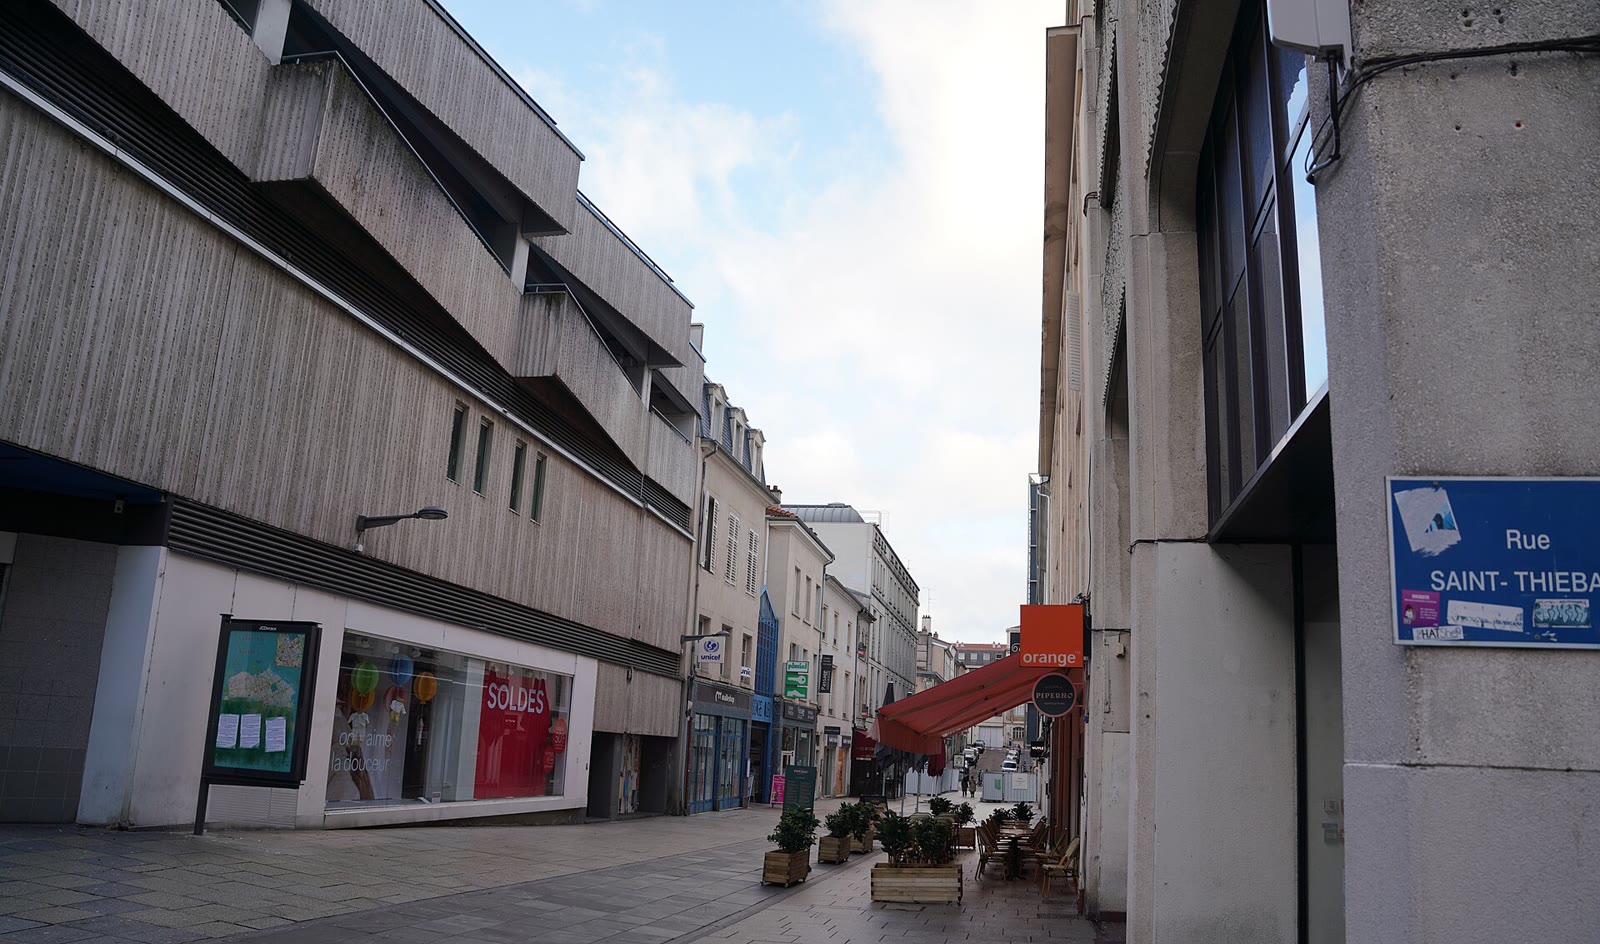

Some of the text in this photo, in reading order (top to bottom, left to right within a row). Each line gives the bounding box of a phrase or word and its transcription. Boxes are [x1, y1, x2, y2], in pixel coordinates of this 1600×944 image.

[1506, 529, 1550, 550] Rue
[1431, 570, 1508, 591] SAINT-
[700, 653, 721, 661] unicef
[1023, 652, 1077, 666] orange
[487, 682, 545, 715] SOLDES
[343, 752, 391, 772] douceur
